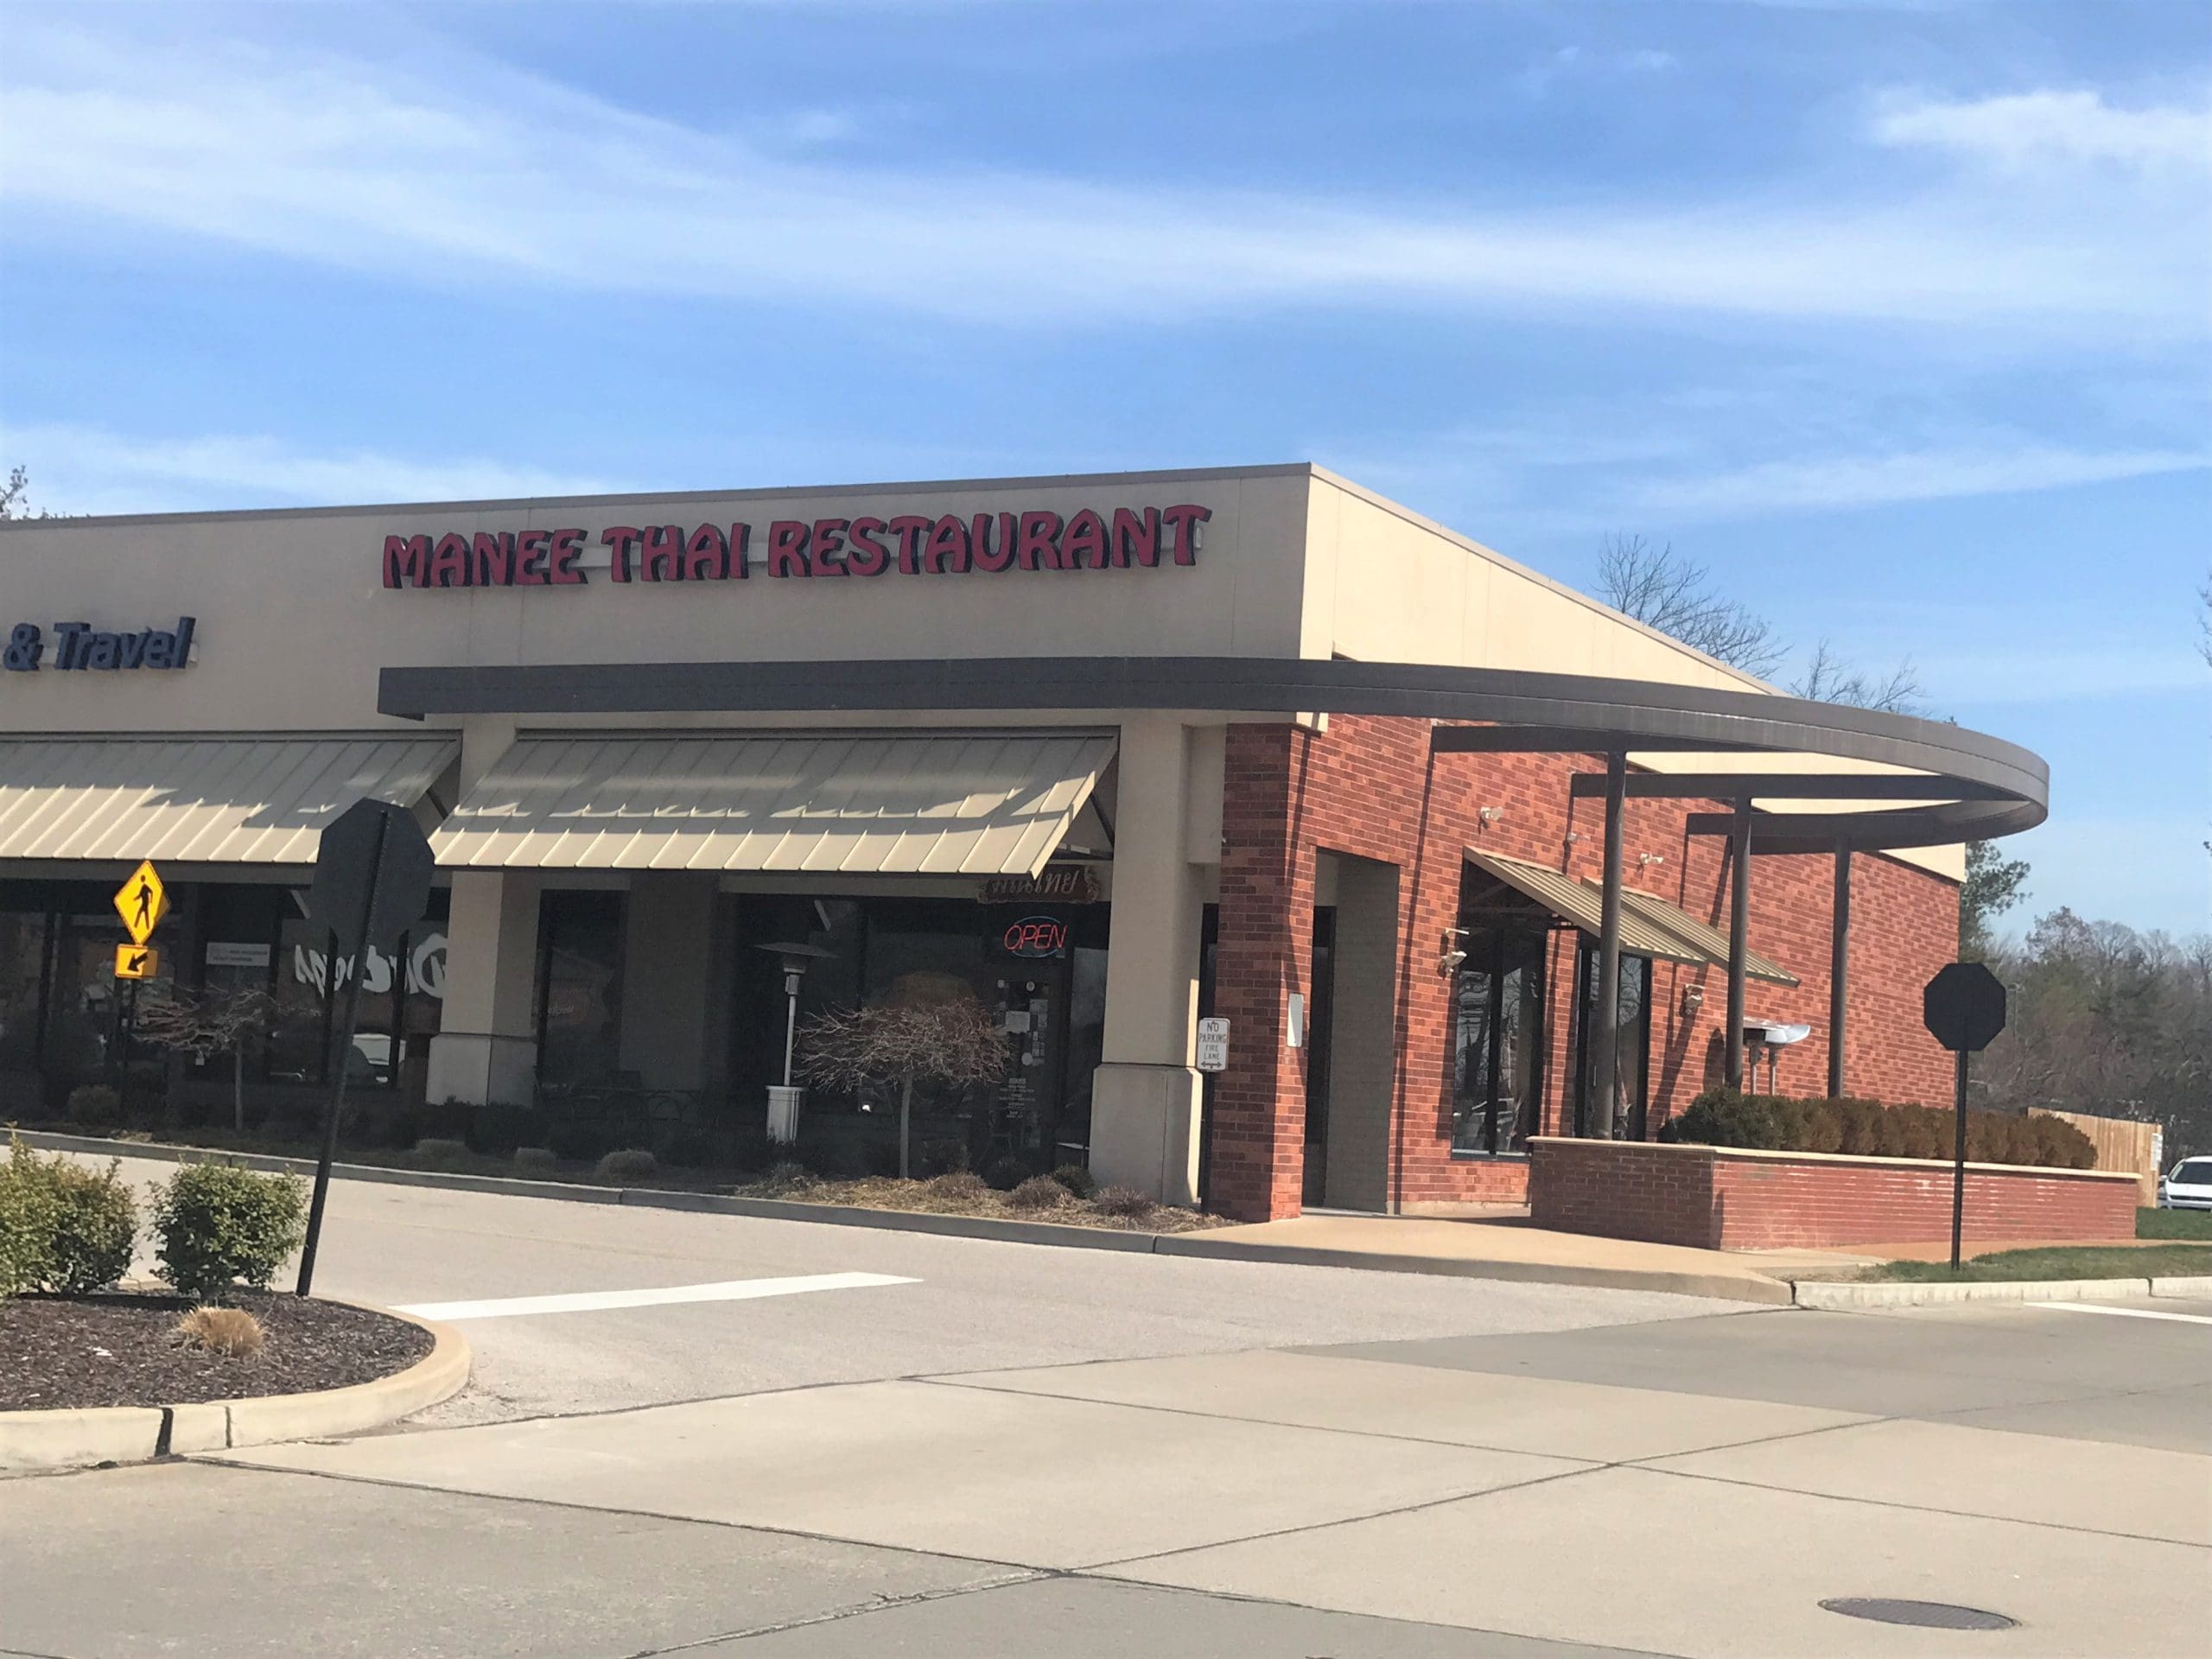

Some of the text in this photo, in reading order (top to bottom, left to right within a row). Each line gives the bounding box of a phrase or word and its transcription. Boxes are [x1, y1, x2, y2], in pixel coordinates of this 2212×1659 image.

[383, 505, 1211, 589] MANEE THAI RESTAURANT
[3, 616, 195, 671] & Travel
[1003, 924, 1068, 950] OPEN
[1198, 1033, 1227, 1044] PARKING
[1206, 1021, 1219, 1033] NO
